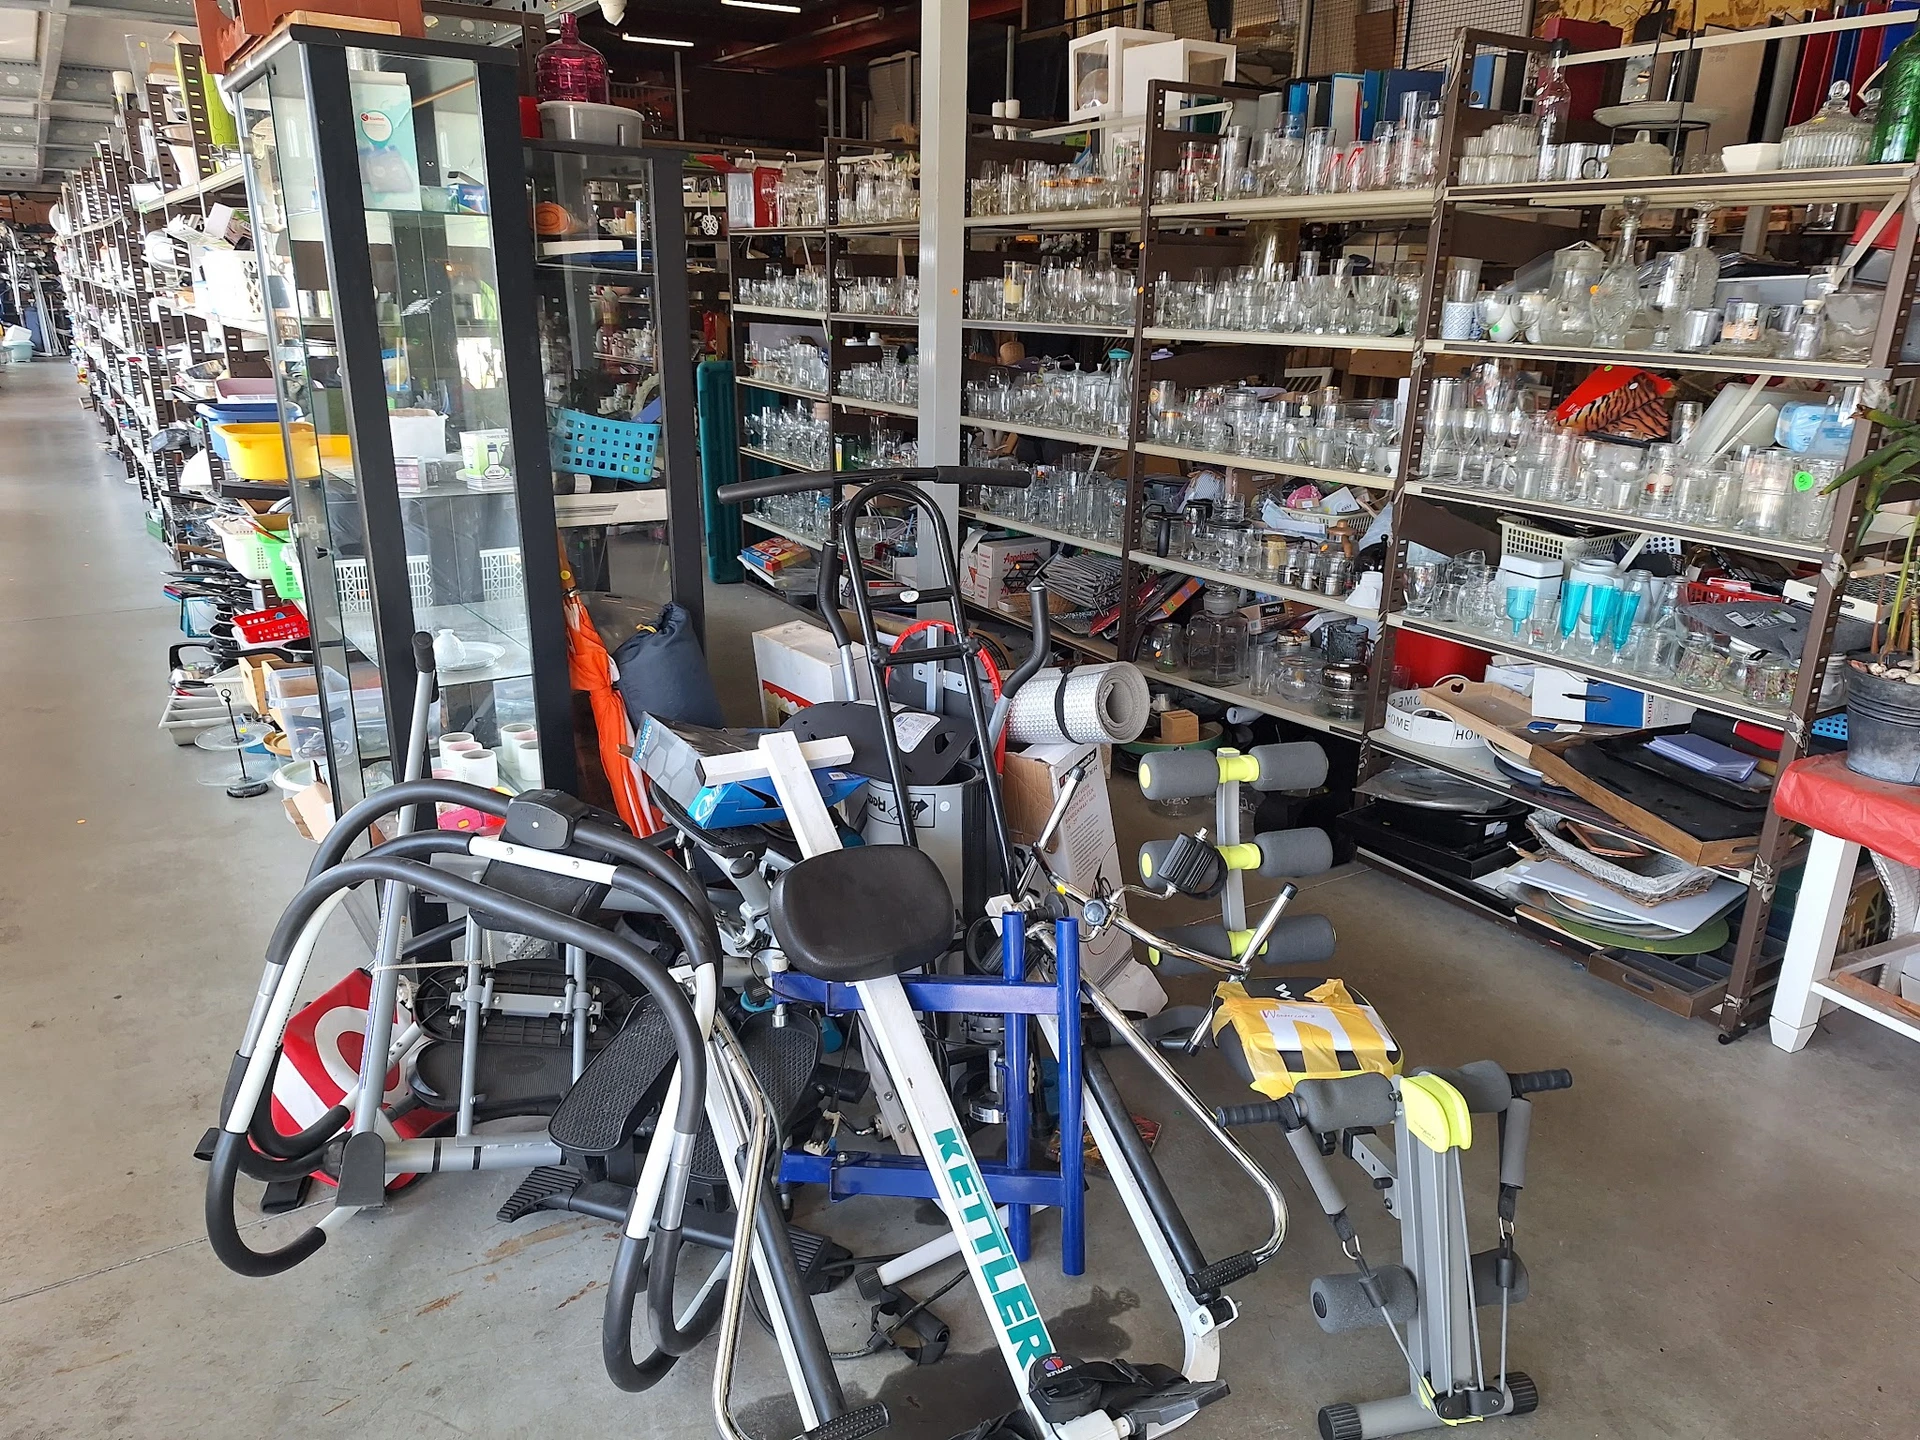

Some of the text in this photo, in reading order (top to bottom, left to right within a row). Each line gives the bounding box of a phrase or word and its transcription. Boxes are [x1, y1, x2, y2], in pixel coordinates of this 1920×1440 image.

[1265, 605, 1281, 613] Handy
[1455, 728, 1484, 741] HOM
[639, 725, 653, 760] BOARD
[933, 1127, 1057, 1371] KETTLER
[1046, 1364, 1073, 1378] KETTLER
